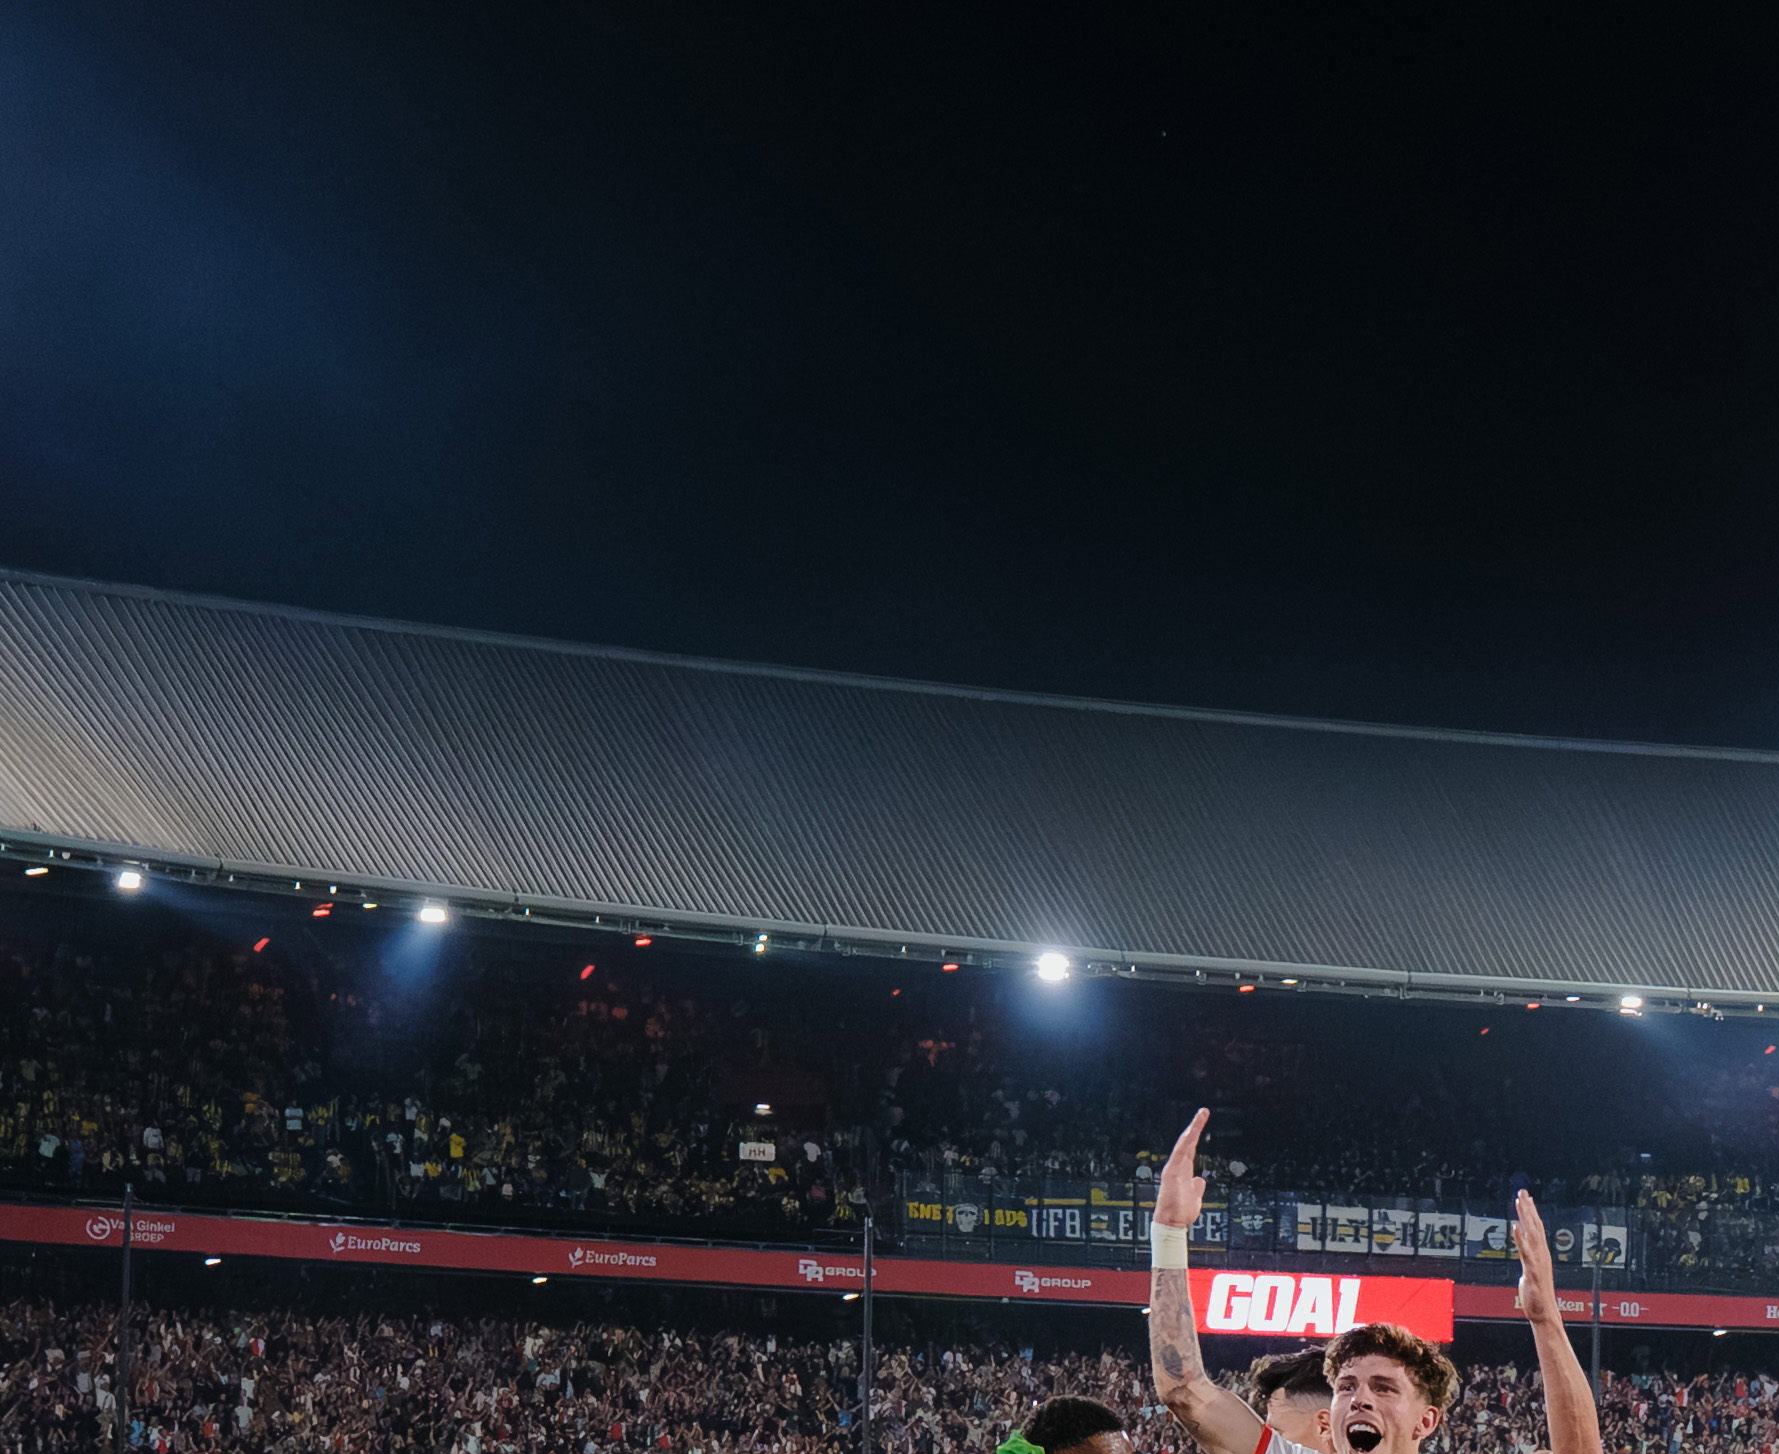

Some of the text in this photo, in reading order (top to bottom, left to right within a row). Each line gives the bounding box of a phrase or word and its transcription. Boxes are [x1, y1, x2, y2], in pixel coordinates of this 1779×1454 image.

[137, 1219, 175, 1233] Ginkel
[1119, 1210, 1221, 1241] EUPE
[347, 1235, 421, 1253] EuroParcs
[586, 1250, 657, 1267] EuroParcs
[1041, 1277, 1092, 1289] GROUP
[1206, 1273, 1368, 1334] GOAL
